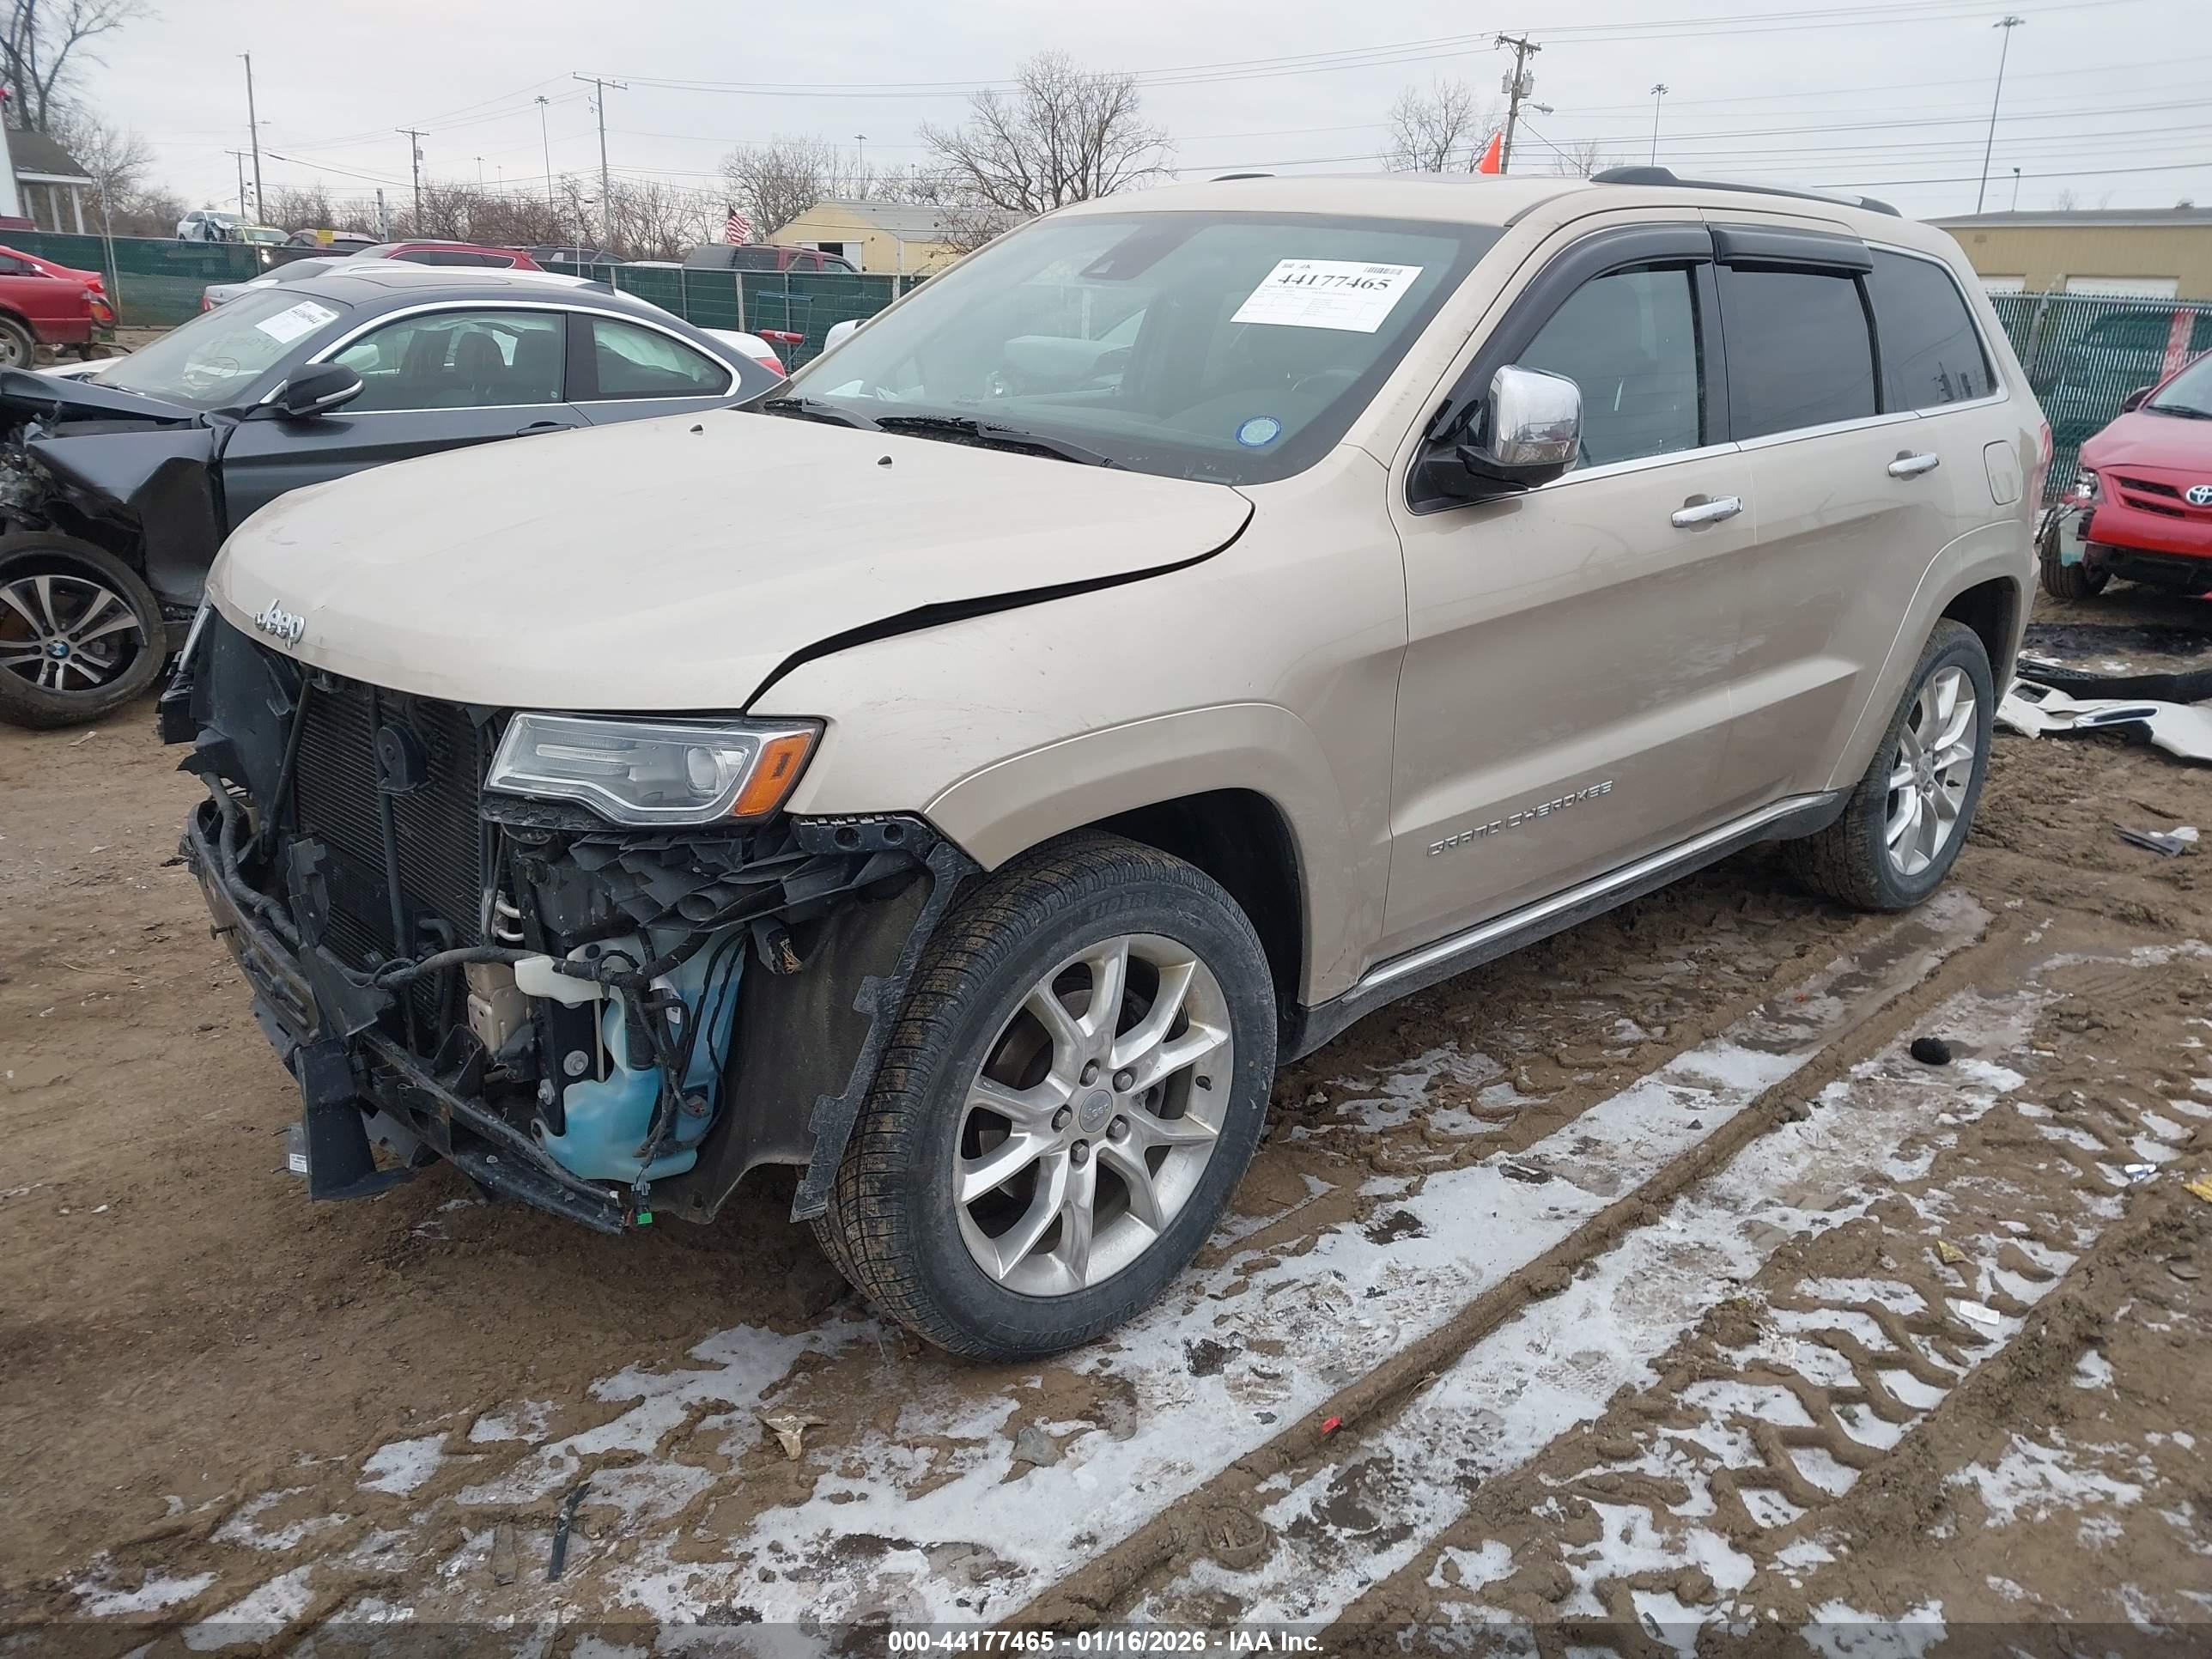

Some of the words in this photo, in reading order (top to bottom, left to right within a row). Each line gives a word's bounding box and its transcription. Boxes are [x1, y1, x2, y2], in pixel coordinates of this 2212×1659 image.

[1277, 273, 1393, 291] 44177465
[254, 599, 306, 650] Jeep
[1426, 819, 1503, 857] GRAND
[1506, 780, 1613, 829] CHEROKEE
